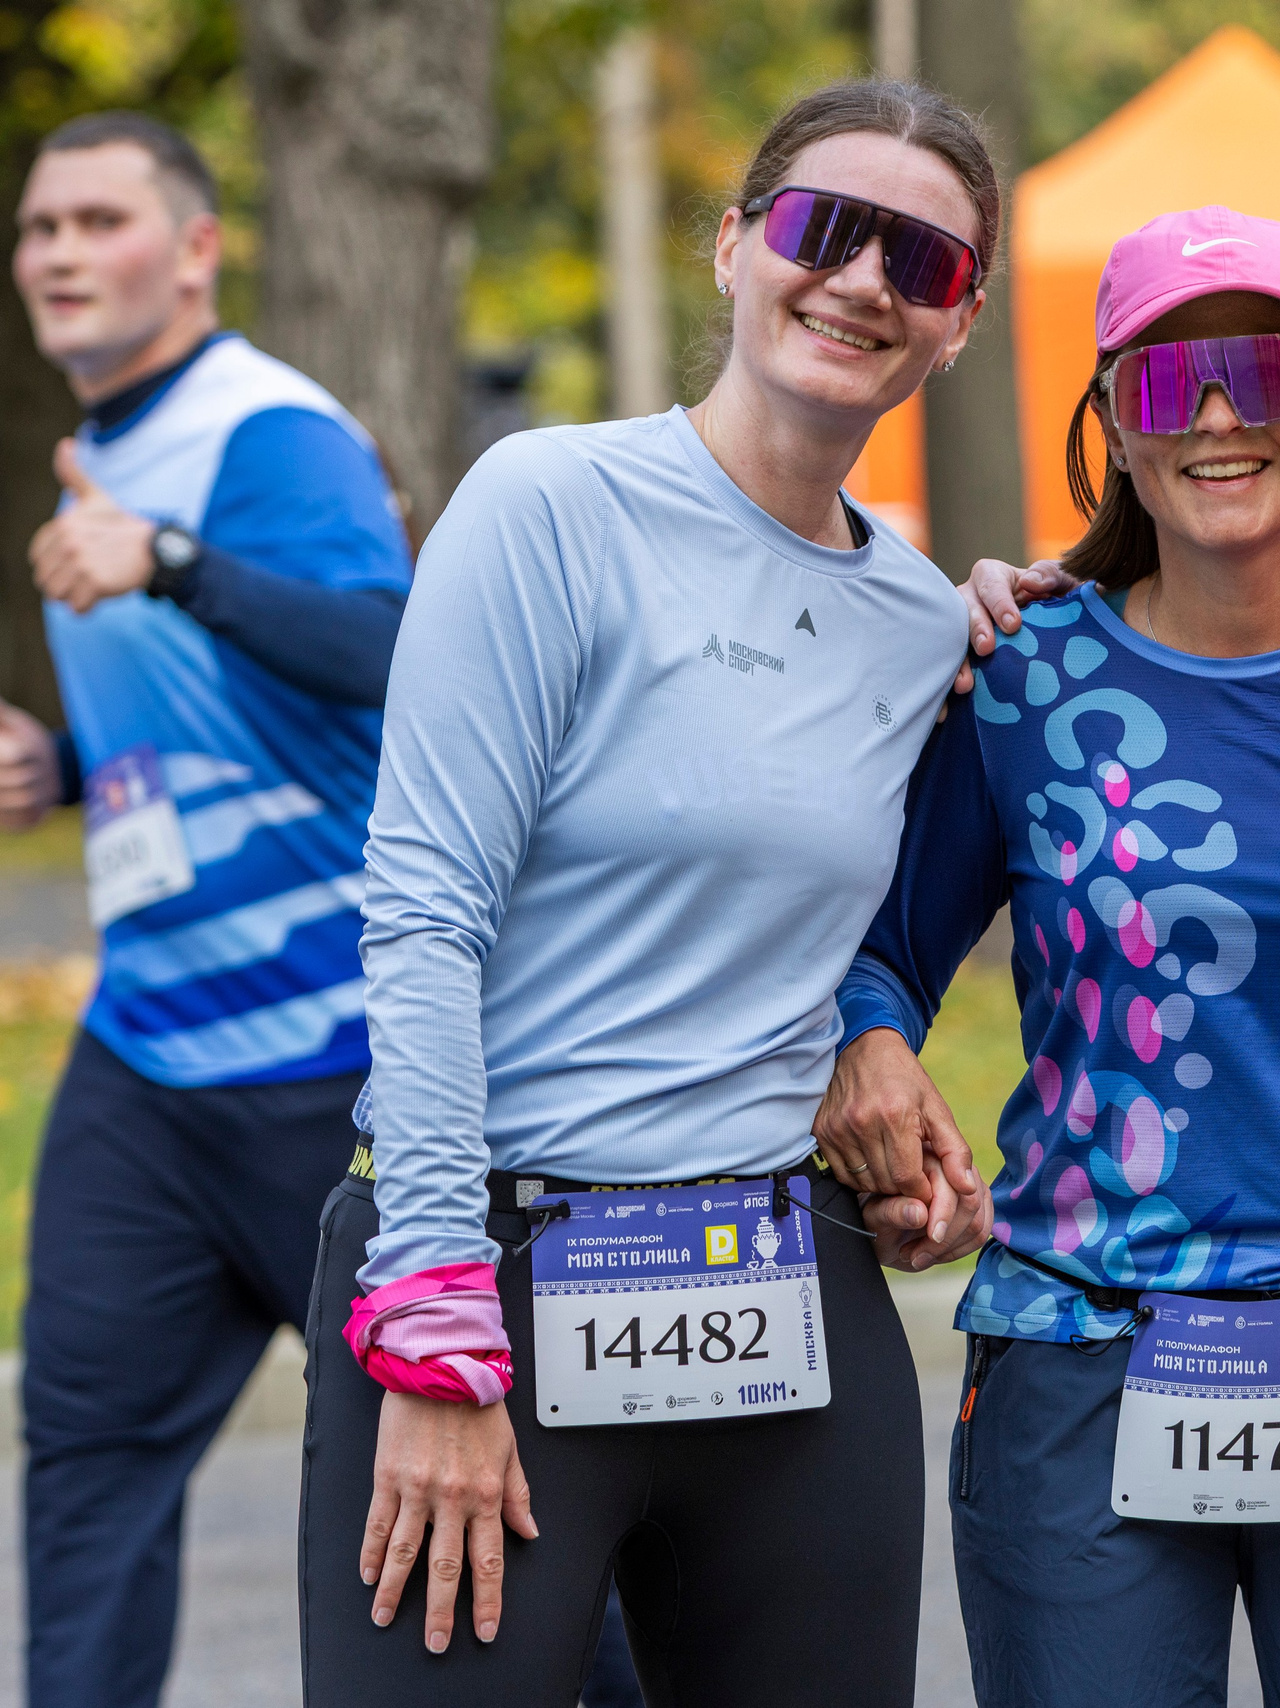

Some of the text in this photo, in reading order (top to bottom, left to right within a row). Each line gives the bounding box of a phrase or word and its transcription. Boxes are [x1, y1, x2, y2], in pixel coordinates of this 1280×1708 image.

[728, 639, 785, 675] МОСКОВСКИЙ
[728, 654, 755, 677] СПОРТ
[752, 1196, 770, 1208] ПСБ
[579, 1234, 664, 1247] ПОЛУМАРАФОН
[709, 1228, 735, 1256] D
[567, 1247, 691, 1269] МОЯ СТОЛИЦА
[710, 1255, 735, 1263] КЛАСТЕР
[574, 1307, 770, 1371] 14482
[803, 1310, 818, 1371] МОСКВА
[1164, 1340, 1241, 1354] ПОЛУМАРАФОН
[1153, 1353, 1268, 1375] МОЯ СТОЛИЦА
[737, 1381, 787, 1405] 10КМ
